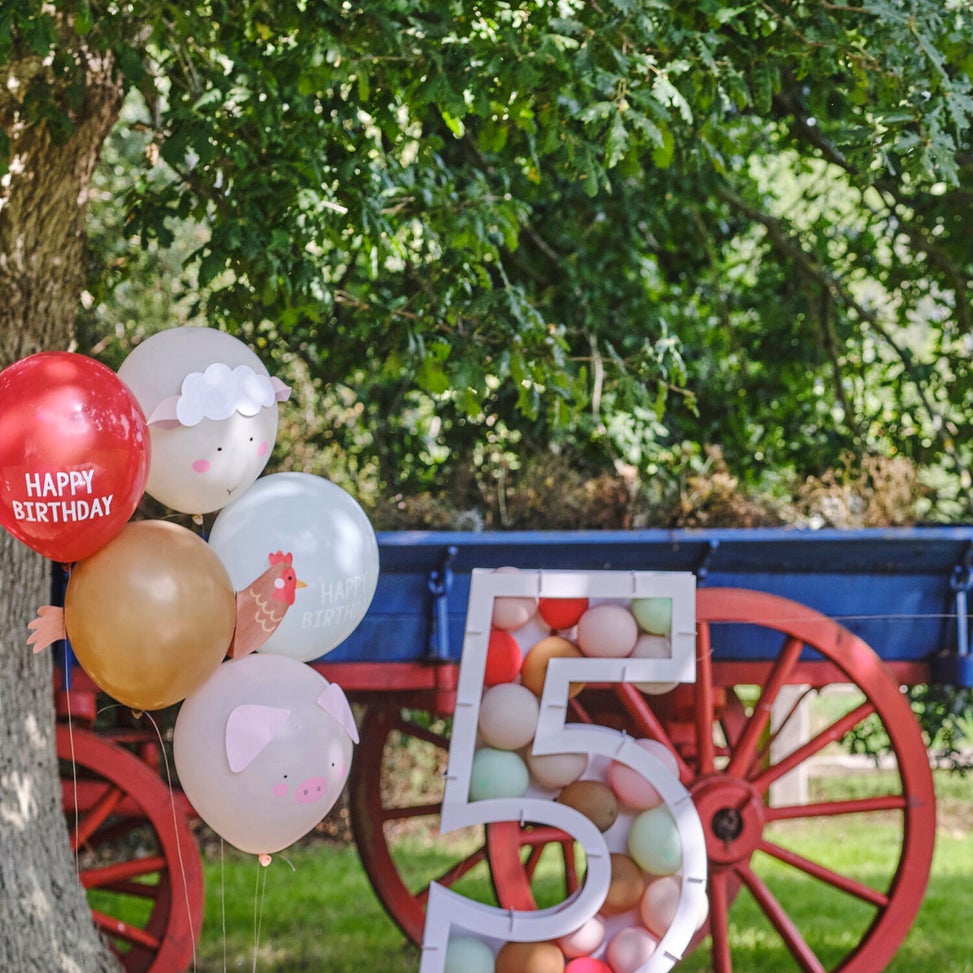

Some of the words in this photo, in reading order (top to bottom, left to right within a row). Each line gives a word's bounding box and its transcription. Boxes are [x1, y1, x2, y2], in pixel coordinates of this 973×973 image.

[25, 469, 95, 498] HAPPY
[12, 494, 114, 523] BIRTHDAY
[320, 571, 368, 605] HAPPY
